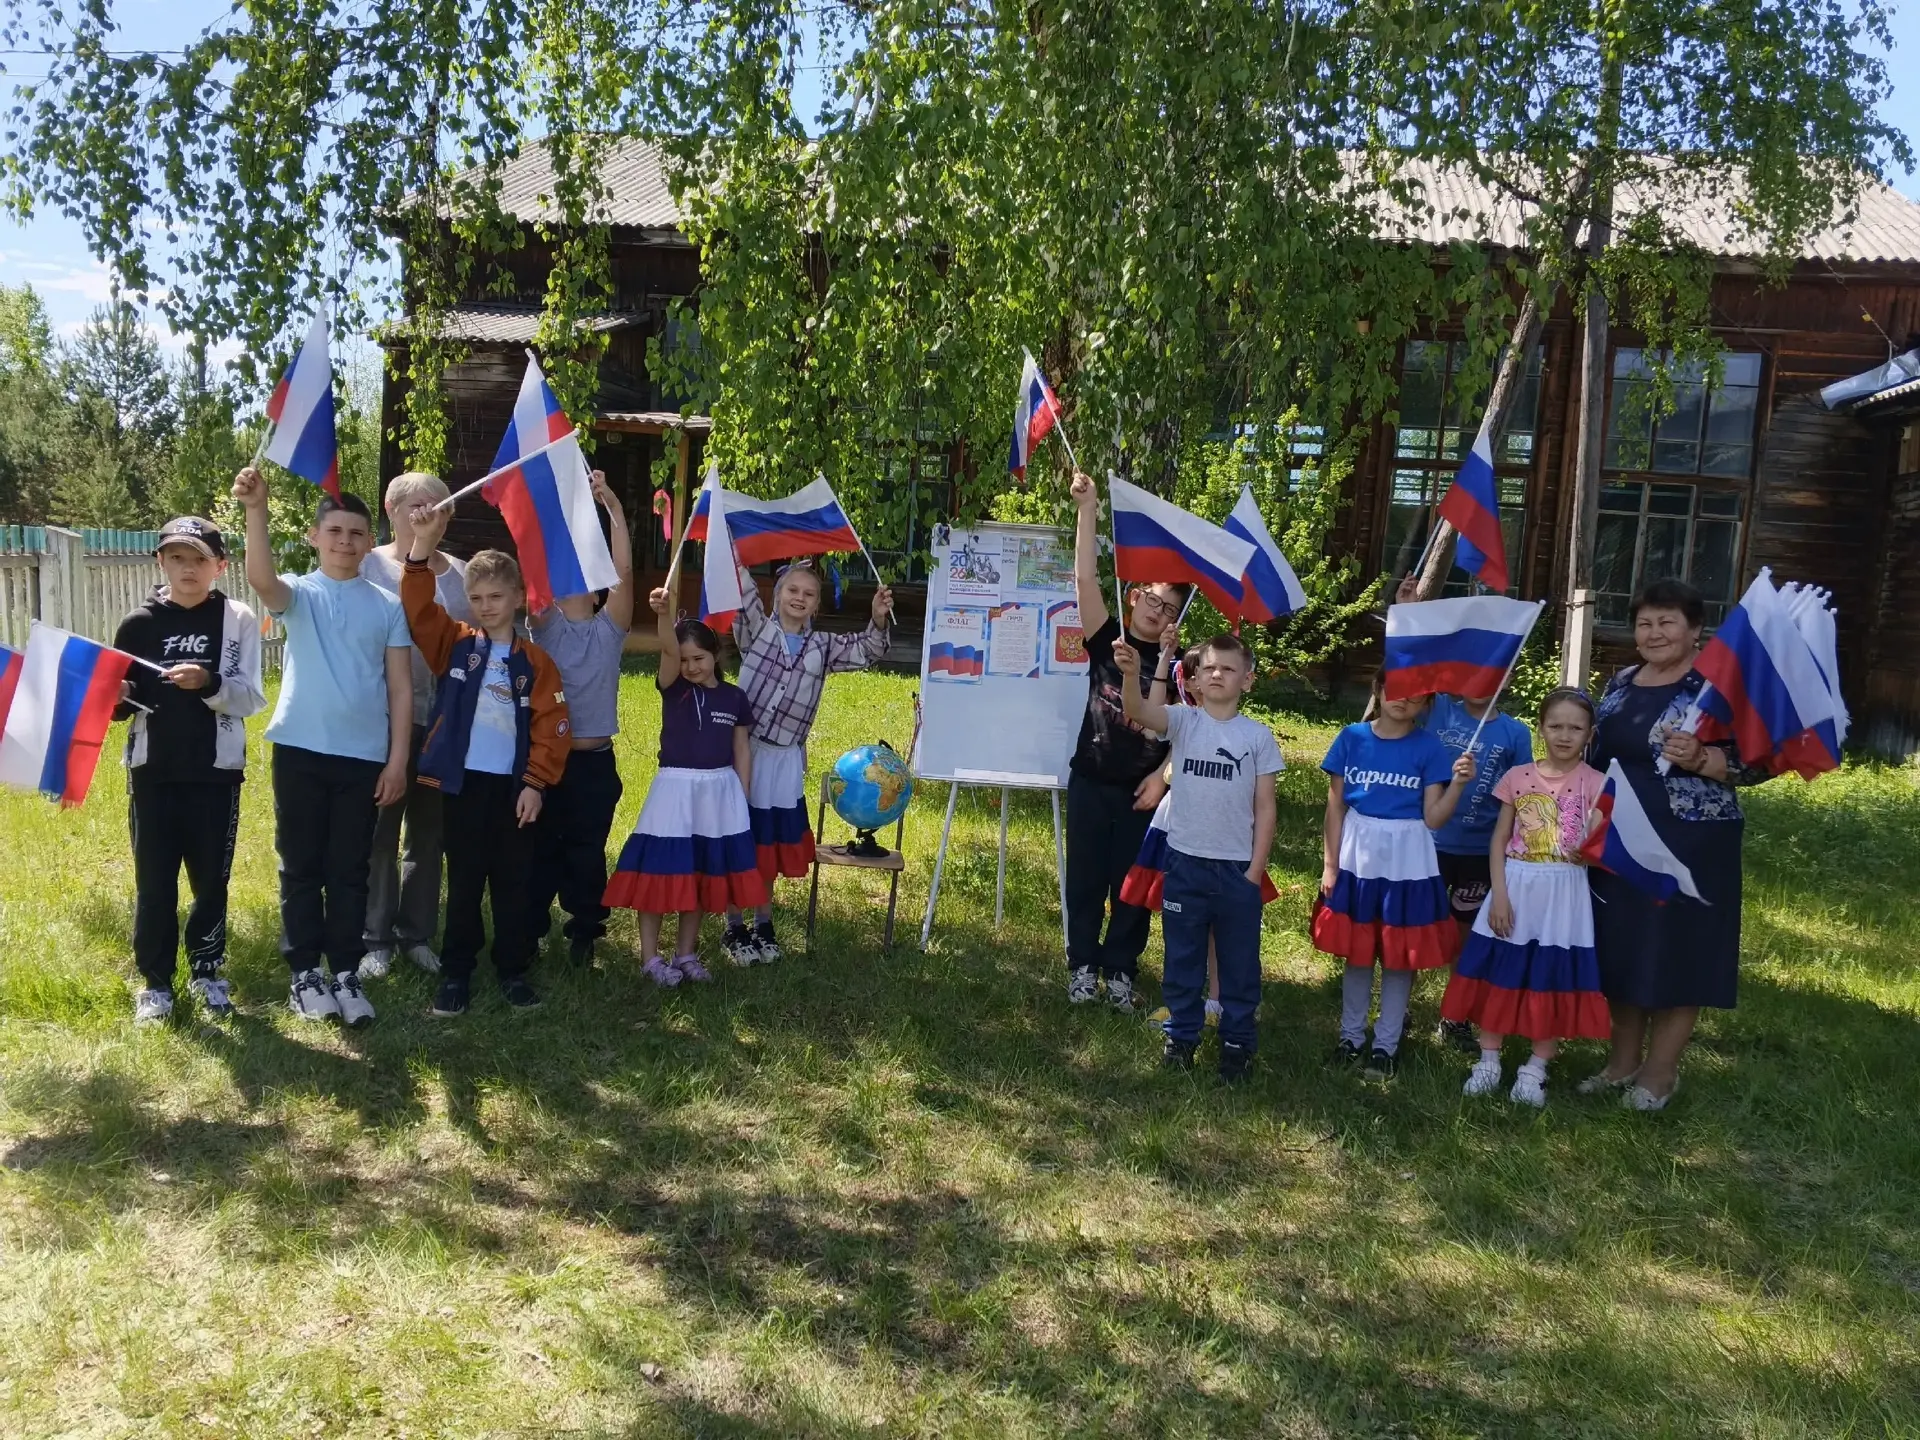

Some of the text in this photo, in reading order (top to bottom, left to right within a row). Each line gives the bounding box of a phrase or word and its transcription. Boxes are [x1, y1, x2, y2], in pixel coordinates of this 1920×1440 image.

[173, 527, 202, 536] LADA
[950, 554, 968, 567] 20
[949, 567, 967, 580] 26
[162, 634, 210, 656] FHG
[1183, 758, 1234, 781] PUMA
[1343, 765, 1422, 792] Карина
